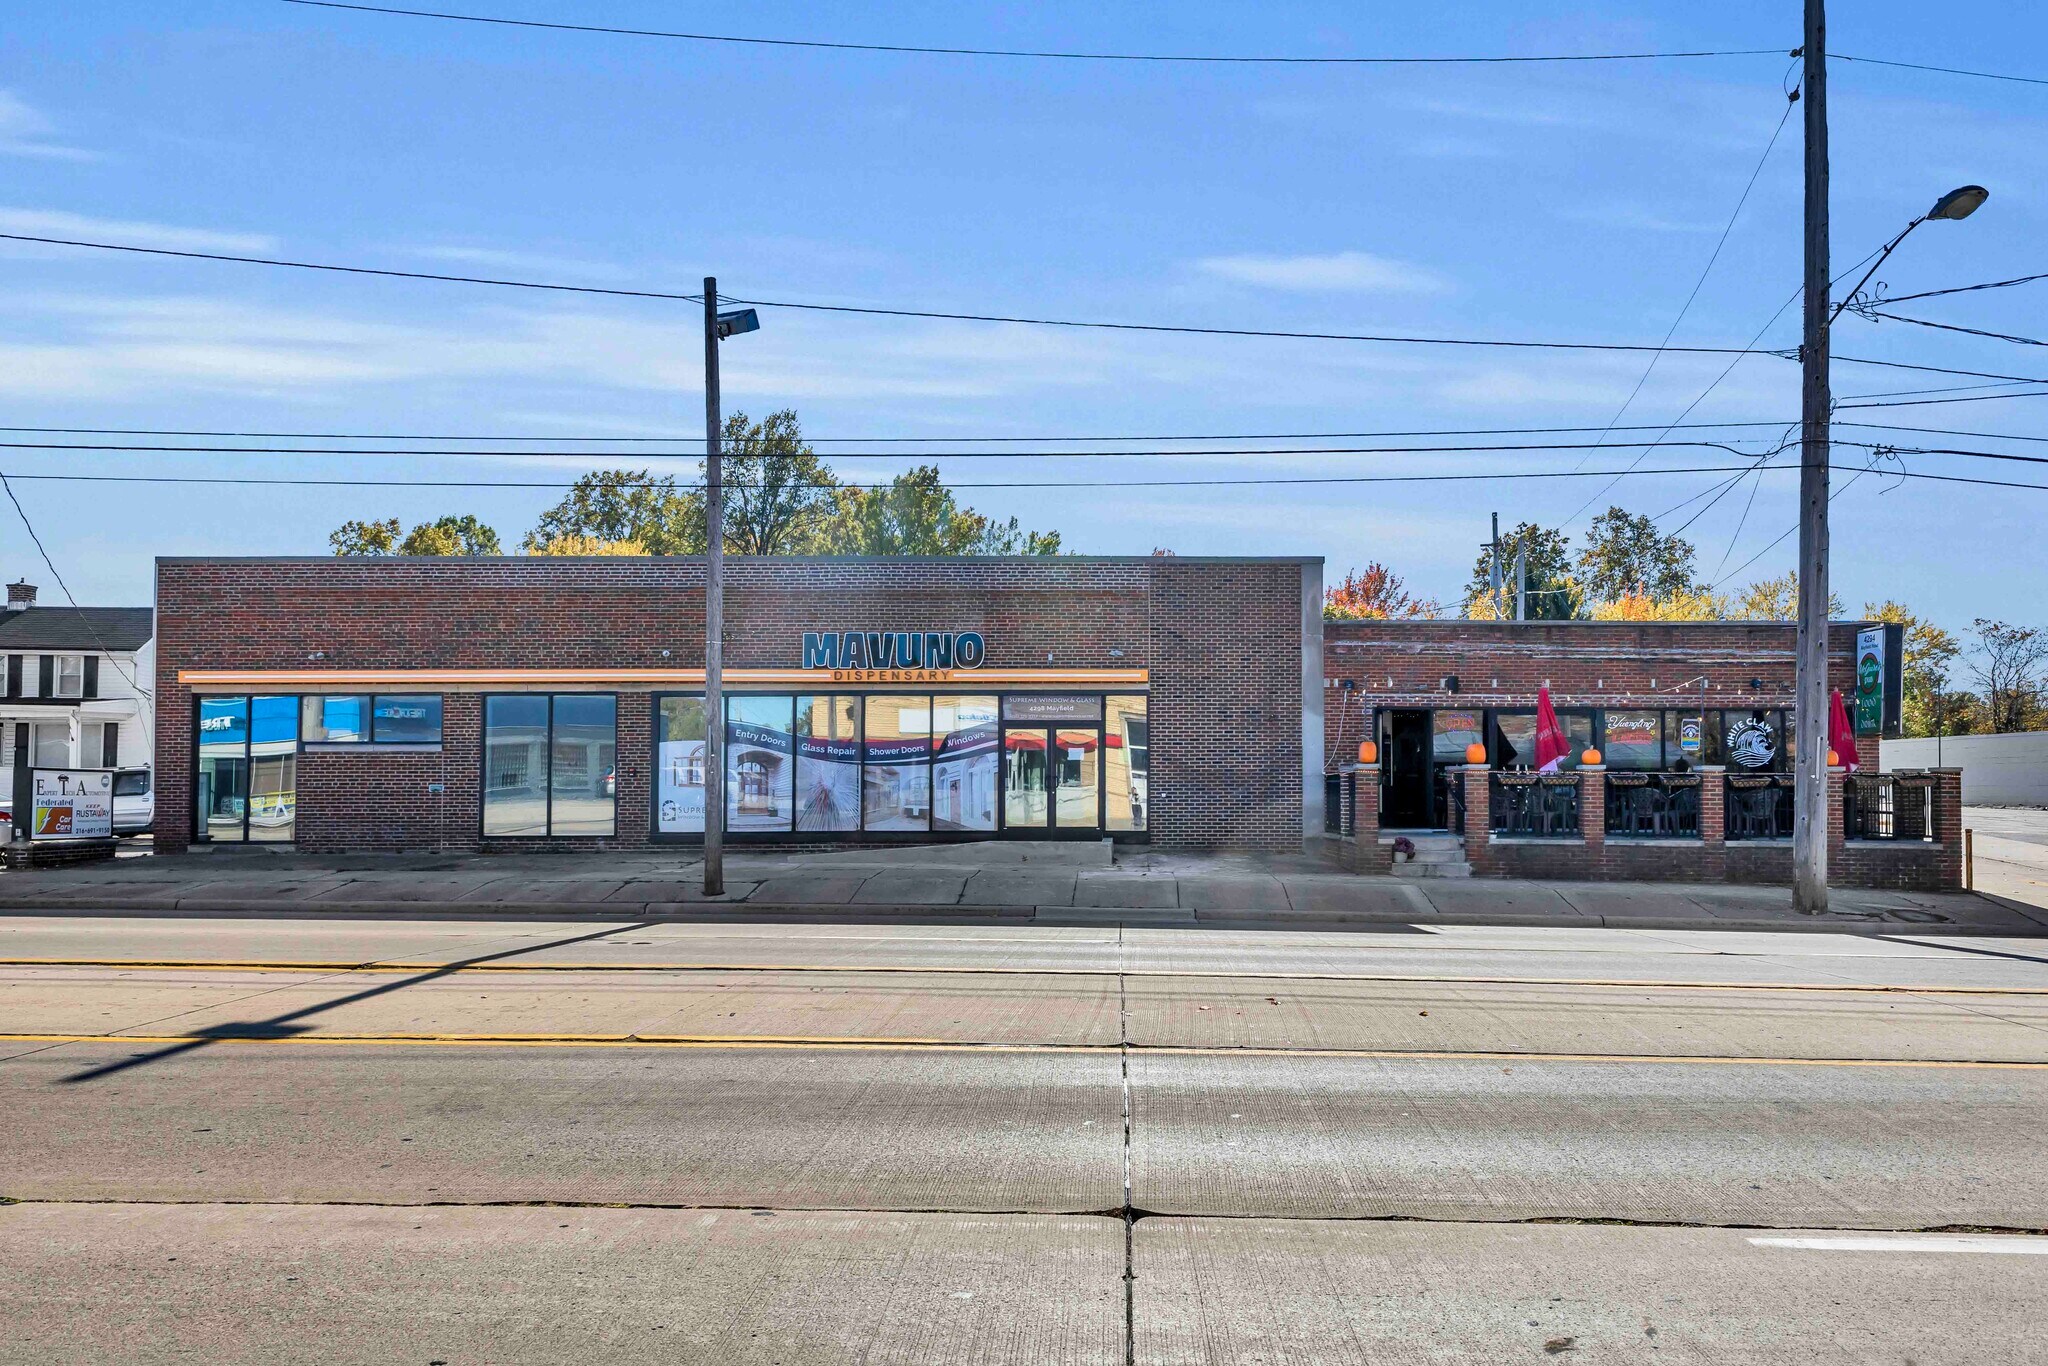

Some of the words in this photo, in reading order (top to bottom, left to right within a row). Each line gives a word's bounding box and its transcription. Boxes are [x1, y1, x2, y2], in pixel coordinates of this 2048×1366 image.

[802, 631, 985, 669] MAVUNO
[834, 670, 951, 680] DISPENSARY
[1608, 716, 1656, 730] Yuengling
[735, 728, 759, 742] Entry
[760, 732, 786, 748] Doors
[946, 730, 986, 747] Windows
[1726, 720, 1745, 748] WHITE
[1746, 717, 1774, 734] CLAW
[801, 742, 826, 754] Glass
[827, 746, 856, 756] Repair
[869, 747, 900, 756] Shower
[901, 744, 925, 754] Doors
